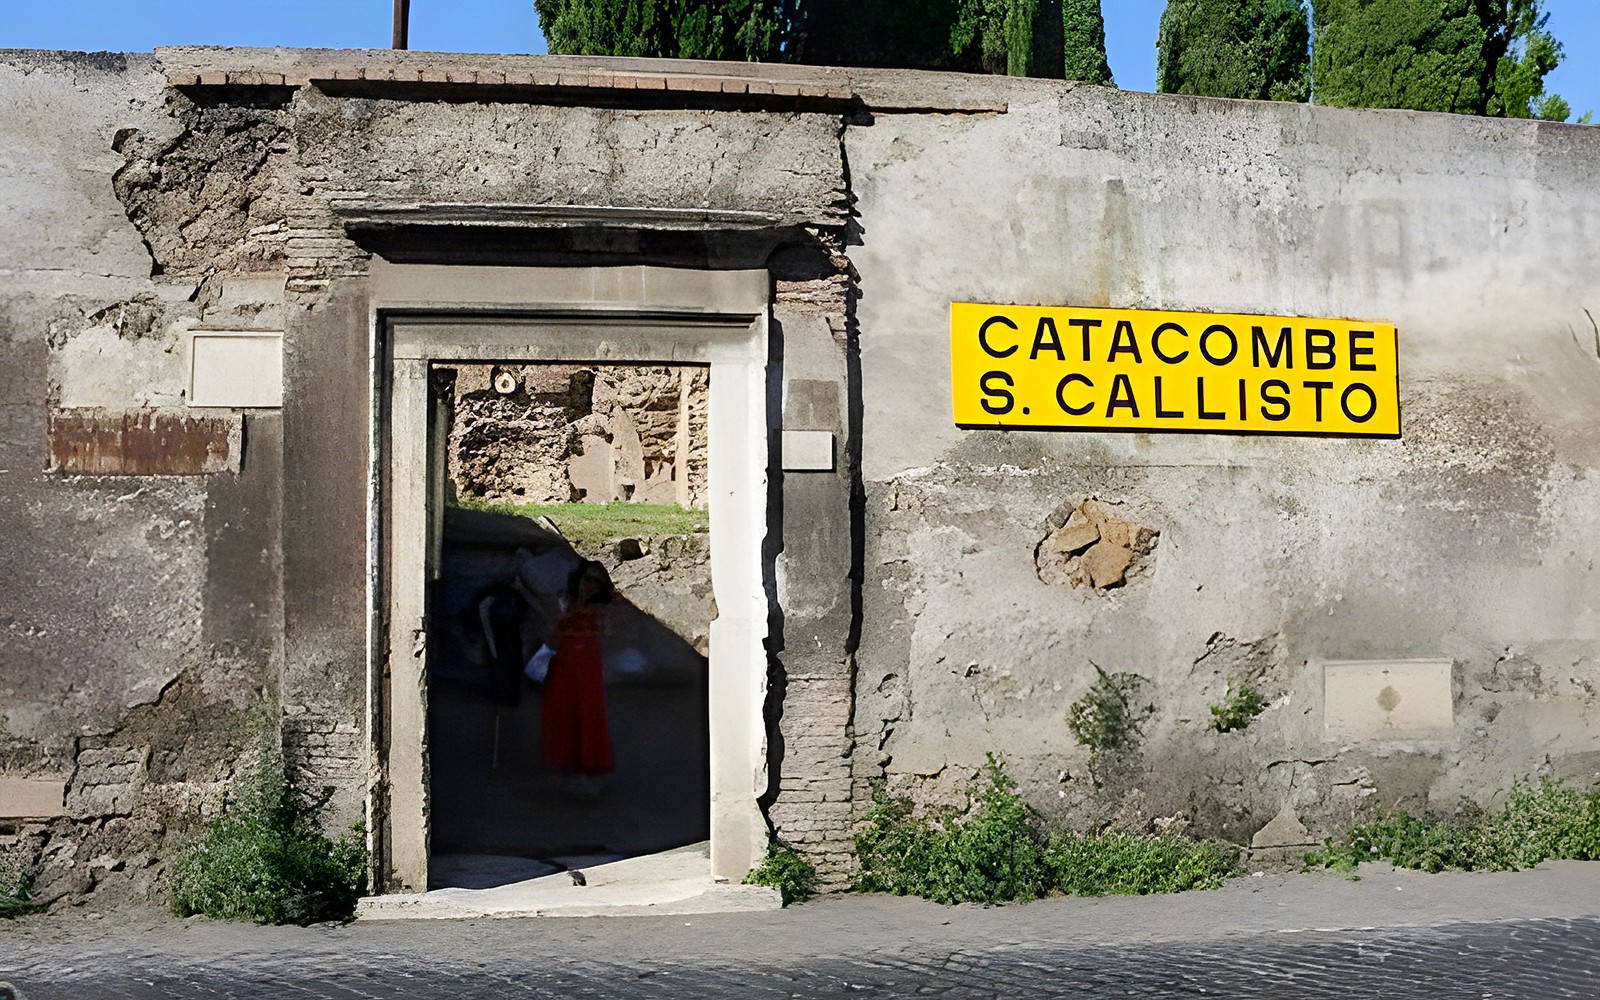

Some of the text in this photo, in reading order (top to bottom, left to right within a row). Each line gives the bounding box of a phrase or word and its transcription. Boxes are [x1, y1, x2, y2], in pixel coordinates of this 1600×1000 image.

[979, 316, 1377, 372] CATACOMBE
[980, 371, 1377, 423] S. CALLISTO
